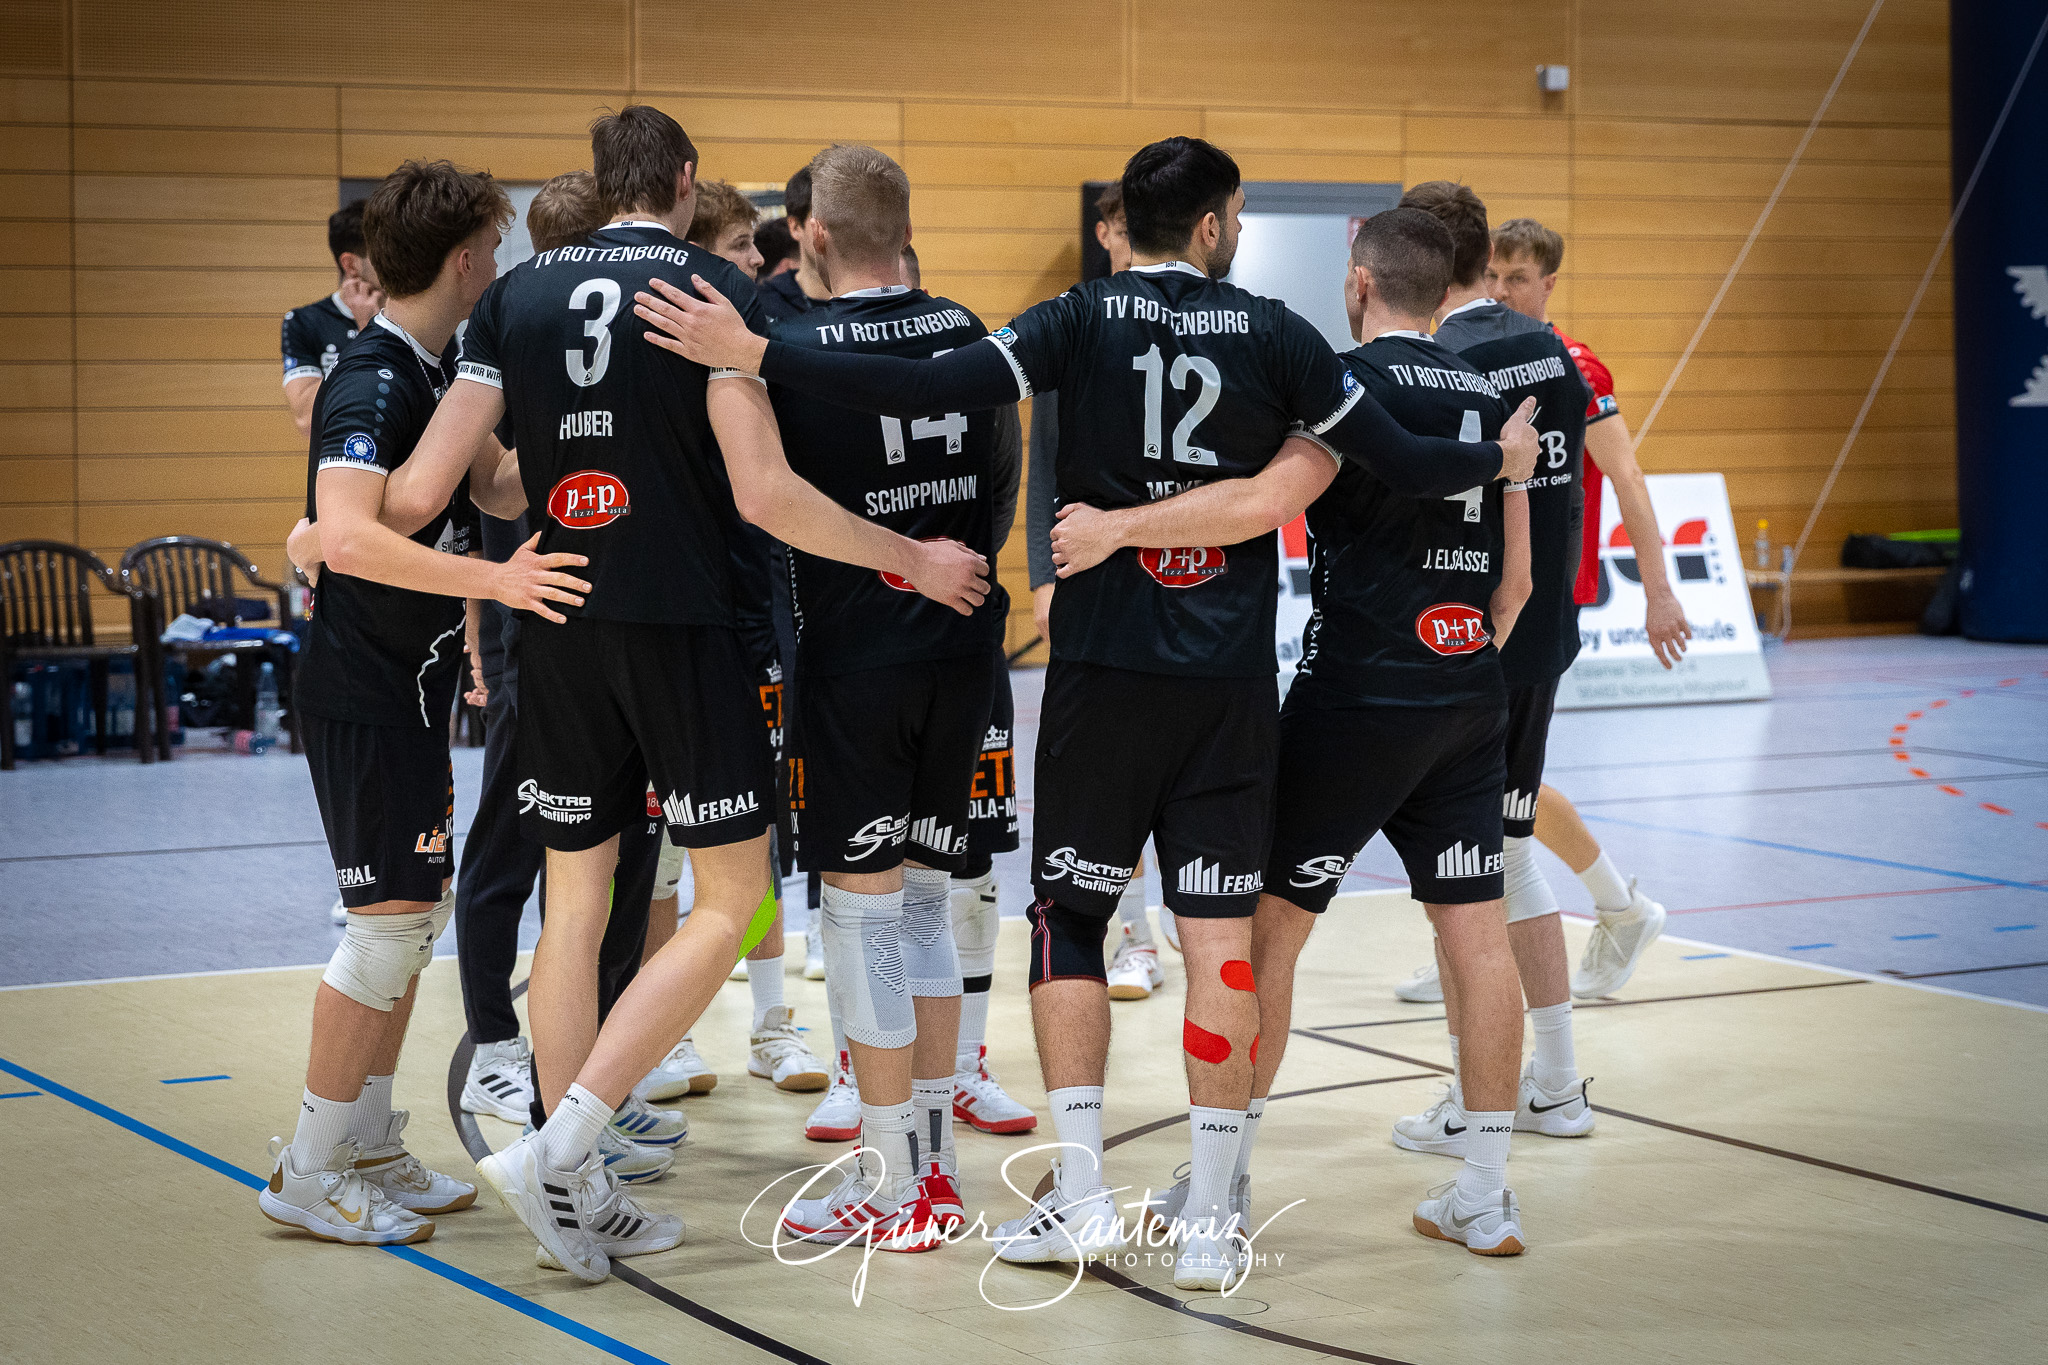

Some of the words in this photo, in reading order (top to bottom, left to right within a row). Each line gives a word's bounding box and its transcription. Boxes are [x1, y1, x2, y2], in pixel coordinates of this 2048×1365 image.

[534, 247, 559, 269] TV
[557, 245, 689, 266] ROTTENBURG
[816, 323, 844, 345] TV
[850, 309, 971, 342] ROTTENBURG
[1103, 295, 1128, 319] TV
[1133, 295, 1249, 336] ROTTENBURG
[566, 278, 622, 387] 3
[1388, 364, 1414, 386] TV
[1132, 343, 1222, 466] 12
[559, 411, 613, 440] HUBER
[1526, 477, 1548, 489] EKT
[865, 475, 977, 516] SCHIPPMANN
[1422, 549, 1432, 569] J.
[538, 805, 592, 824] Sanfilippo
[698, 791, 759, 822] FERAL
[1223, 869, 1264, 893] FERAL
[1065, 1101, 1101, 1112] JAKO
[1200, 1122, 1239, 1133] JAKO
